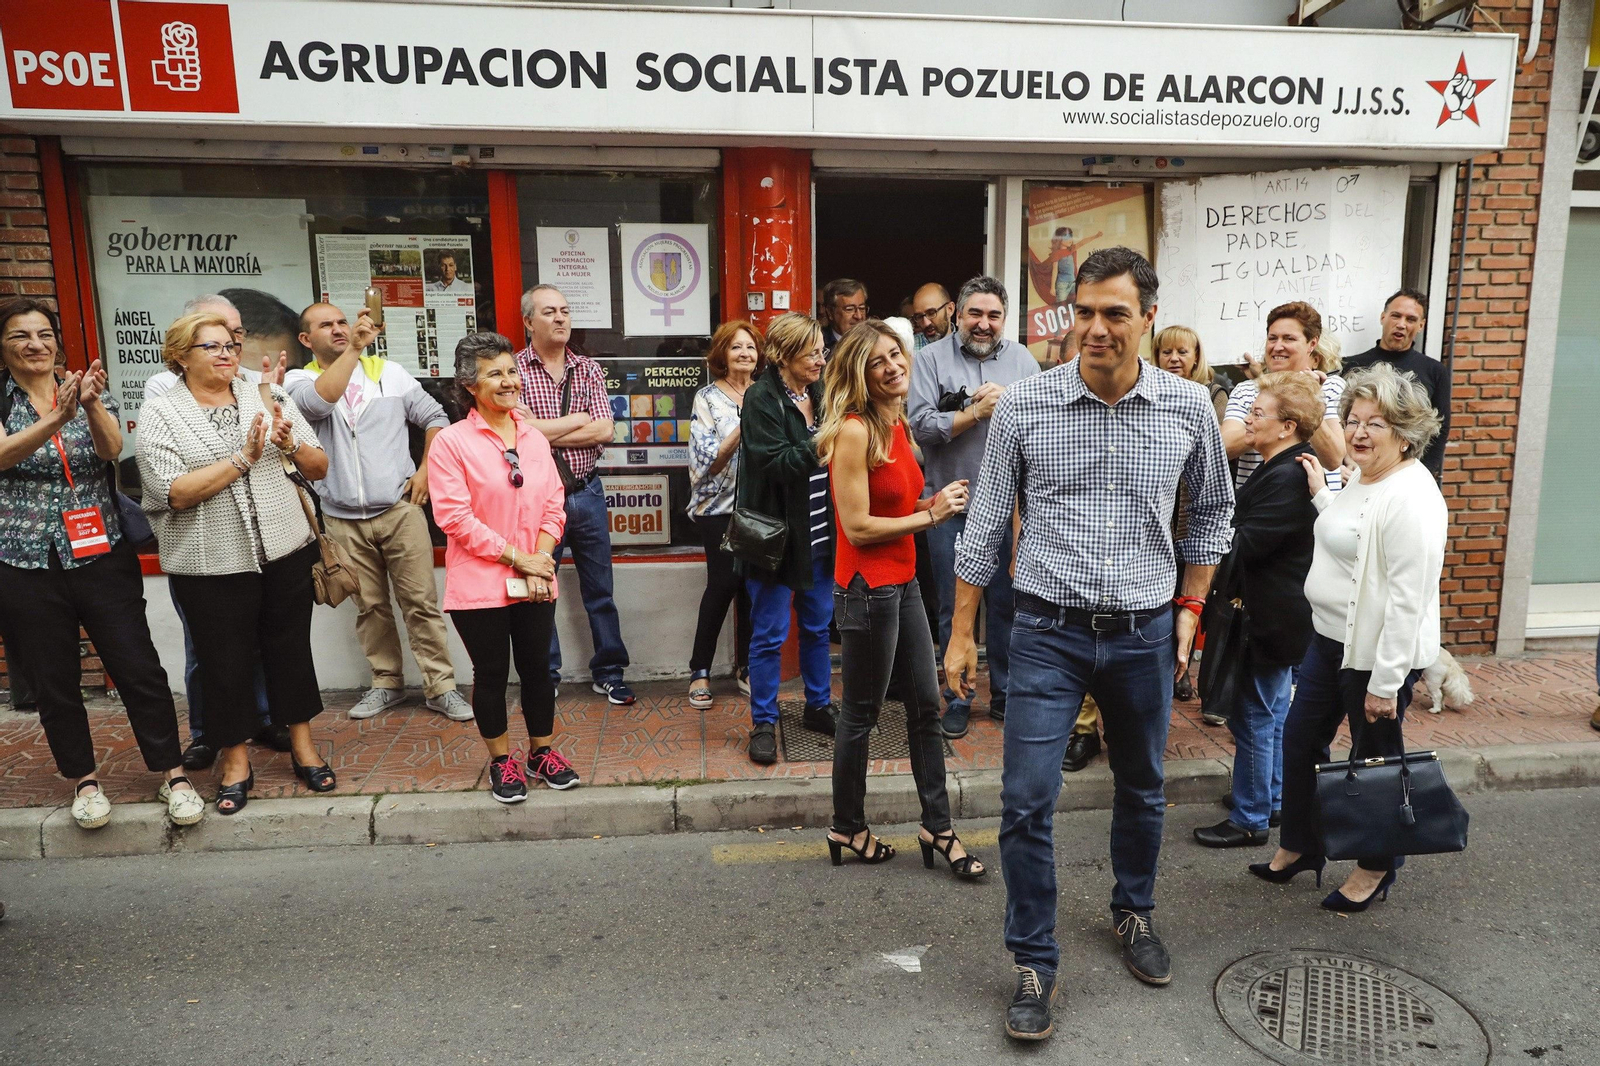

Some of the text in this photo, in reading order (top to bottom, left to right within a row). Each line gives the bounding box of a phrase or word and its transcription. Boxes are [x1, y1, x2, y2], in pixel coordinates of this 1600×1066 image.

[13, 49, 114, 87] PSOE
[260, 40, 1410, 116] AGRUPACION SOCIALISTA POZUELO DE ALARCON J.J.S.S.
[1062, 109, 1321, 133] www.socialistasdepozuelo.org
[1206, 202, 1374, 228] DERECHOS DEL
[107, 226, 238, 257] gobernar
[126, 253, 262, 273] PARA LA MAYORÍA
[1210, 253, 1346, 283] IGUALDAD
[1276, 275, 1320, 295] ANTE
[114, 308, 155, 326] ÁNGEL
[1034, 303, 1075, 337] SOCI
[1220, 300, 1266, 320] LEY
[1328, 314, 1365, 333] BRE
[116, 327, 165, 345] GONZÁL
[118, 349, 164, 364] BASCU
[644, 366, 701, 377] DERECHOS
[648, 377, 699, 388] HUMANOS
[122, 391, 144, 399] POZUE
[606, 493, 662, 508] aborto
[607, 510, 662, 535] legal
